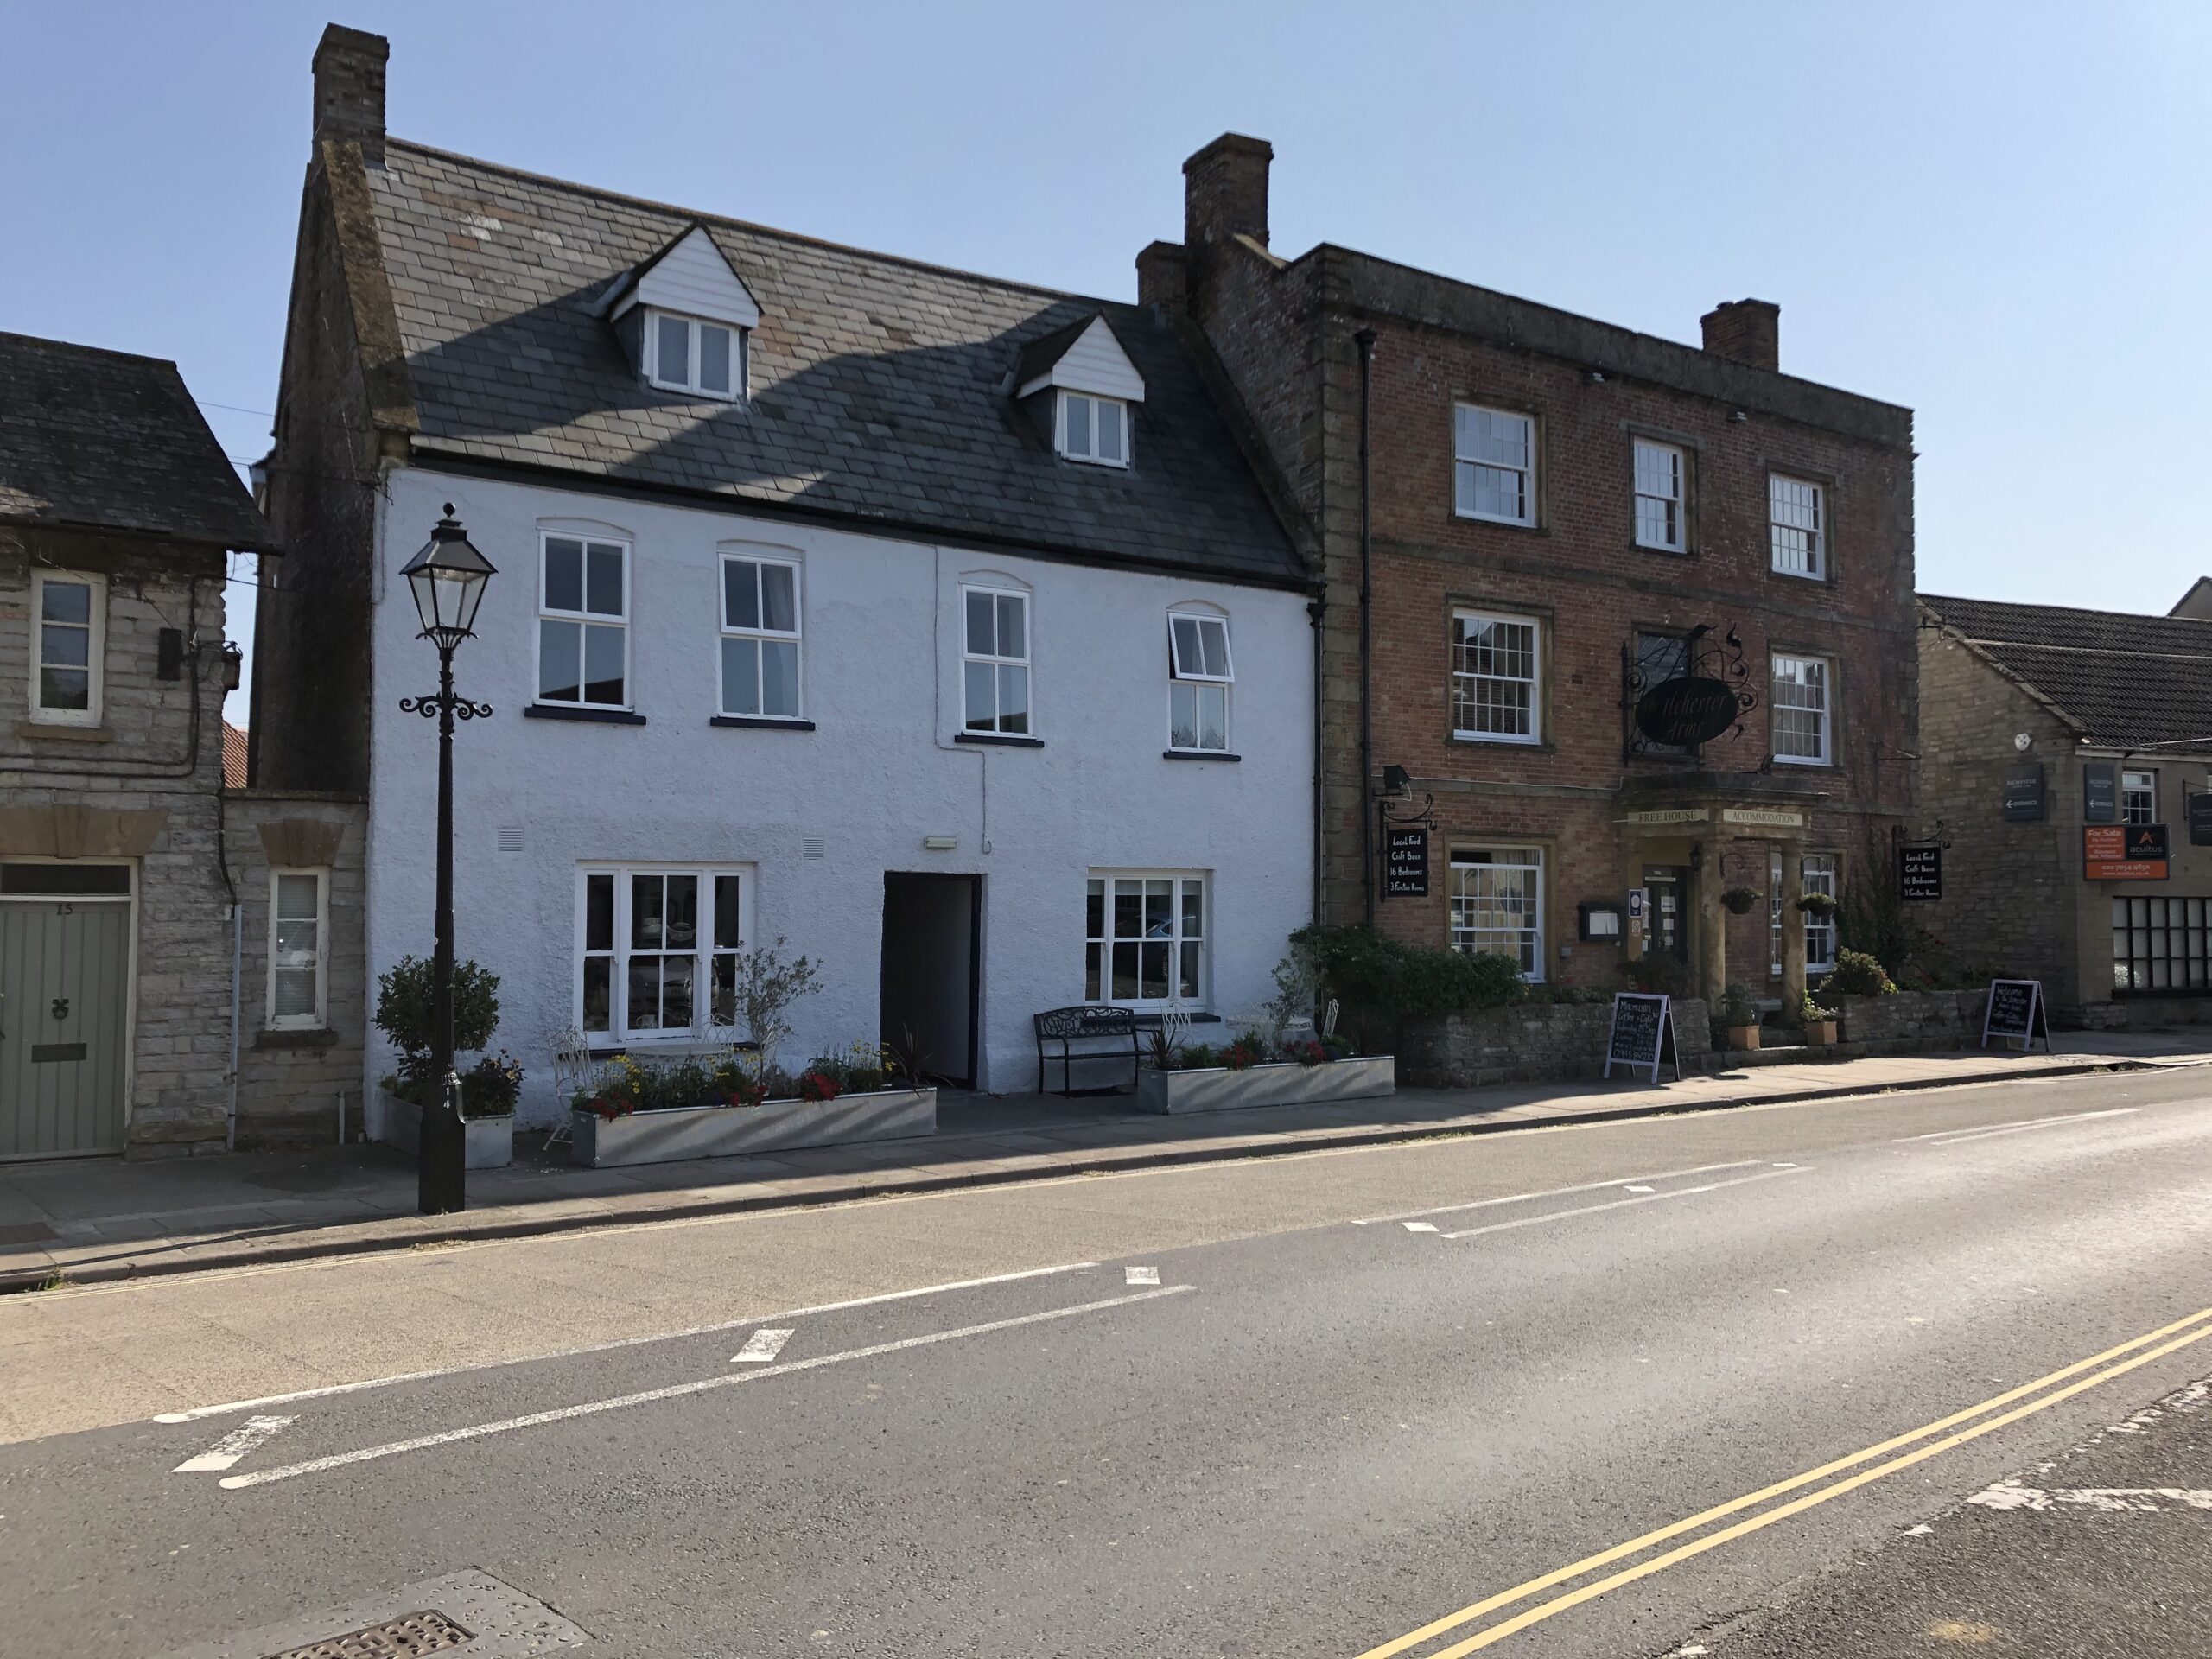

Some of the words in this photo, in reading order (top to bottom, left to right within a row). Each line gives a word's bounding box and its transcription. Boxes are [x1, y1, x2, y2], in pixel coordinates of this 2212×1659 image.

[1639, 813, 1662, 822] FREE
[1664, 810, 1696, 821] HOUSE
[1732, 811, 1795, 823] ACCOMMODATION
[1408, 835, 1421, 845] Food
[2129, 844, 2163, 853] acuitus
[1390, 866, 1397, 876] 16
[1398, 866, 1423, 876] Bedrooms
[1390, 881, 1395, 892] 3
[56, 903, 73, 916] 15
